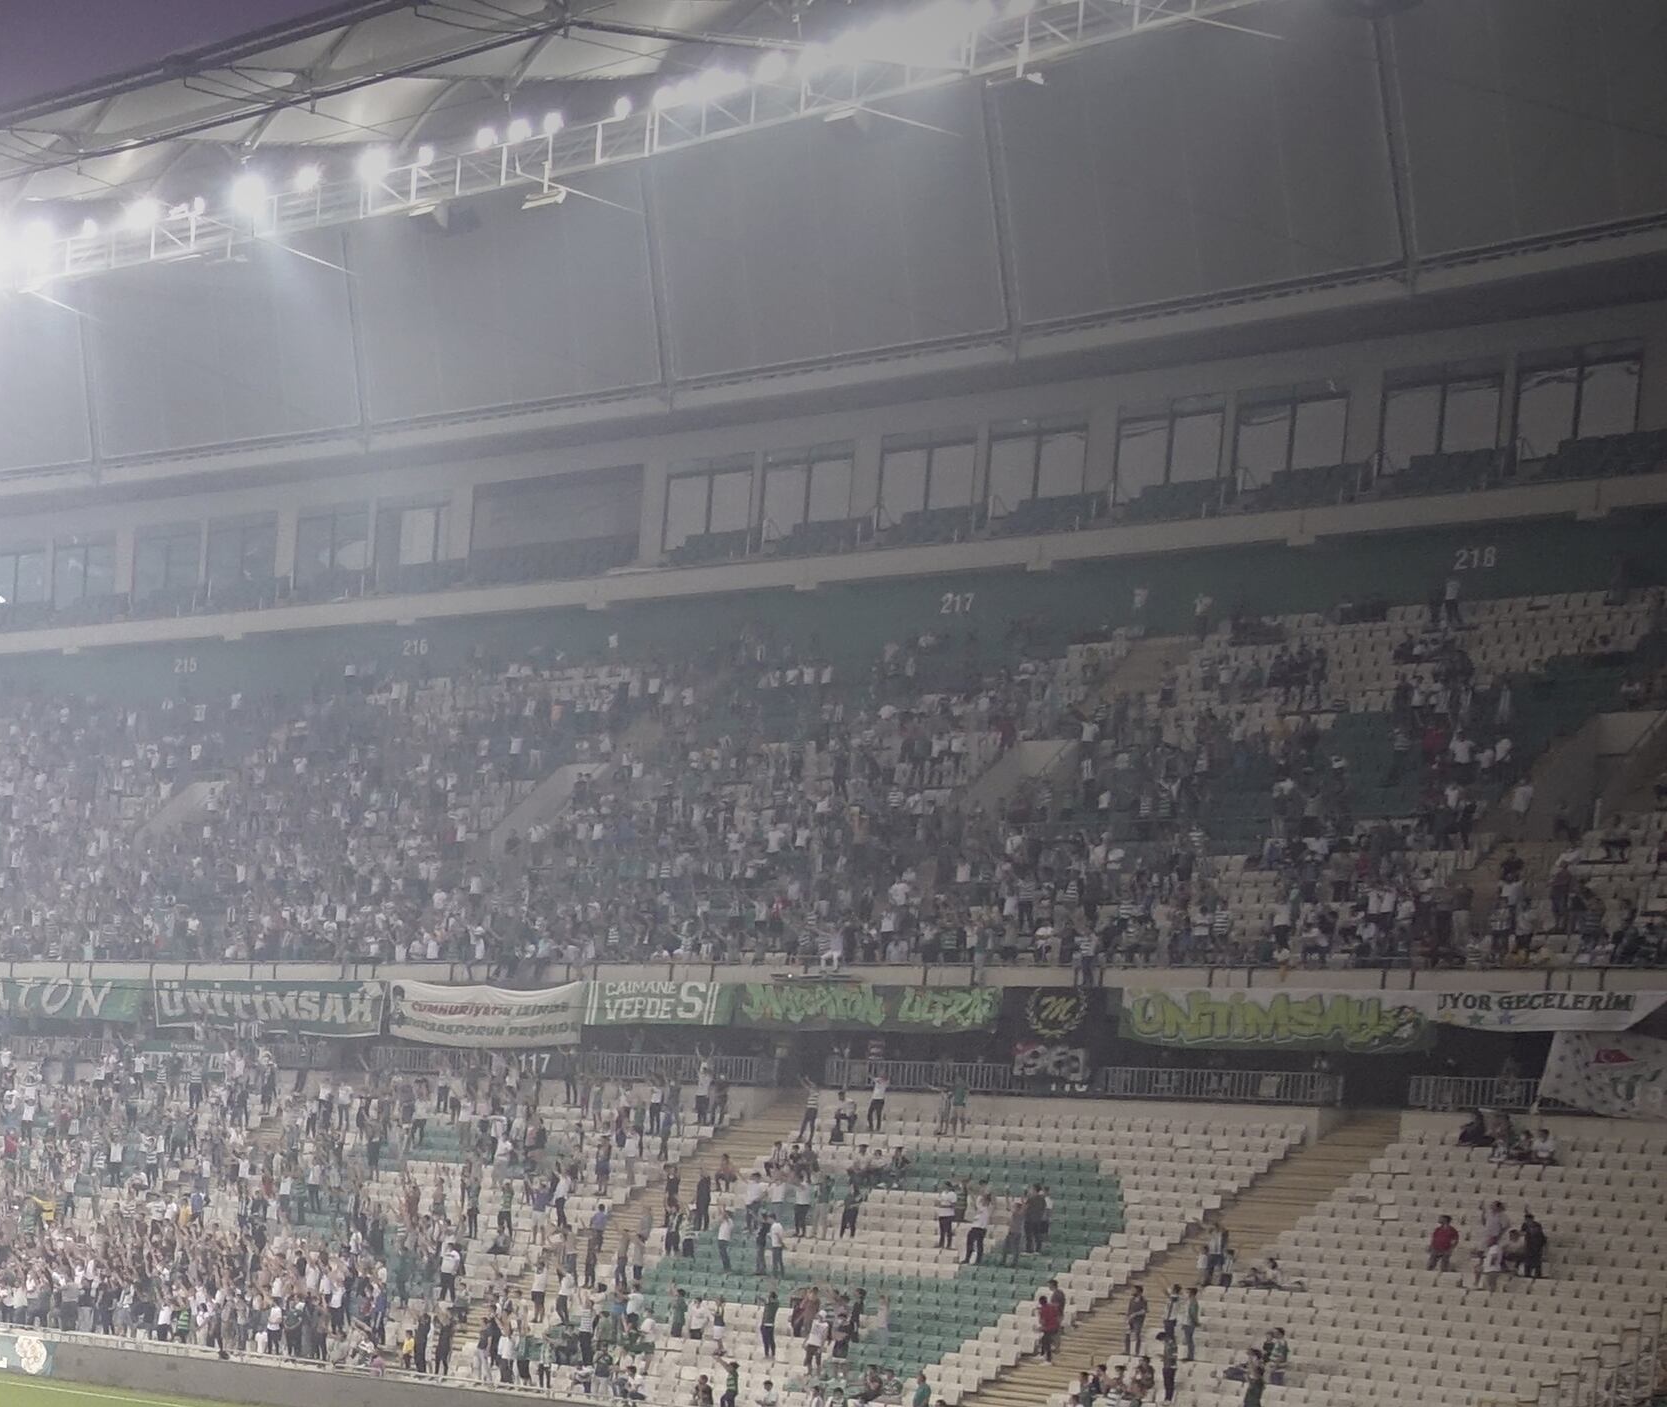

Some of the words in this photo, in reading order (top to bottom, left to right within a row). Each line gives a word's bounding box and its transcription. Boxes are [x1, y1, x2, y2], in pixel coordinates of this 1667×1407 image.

[1453, 546, 1496, 570] 218
[940, 592, 975, 614] 217
[519, 1053, 551, 1073] 117
